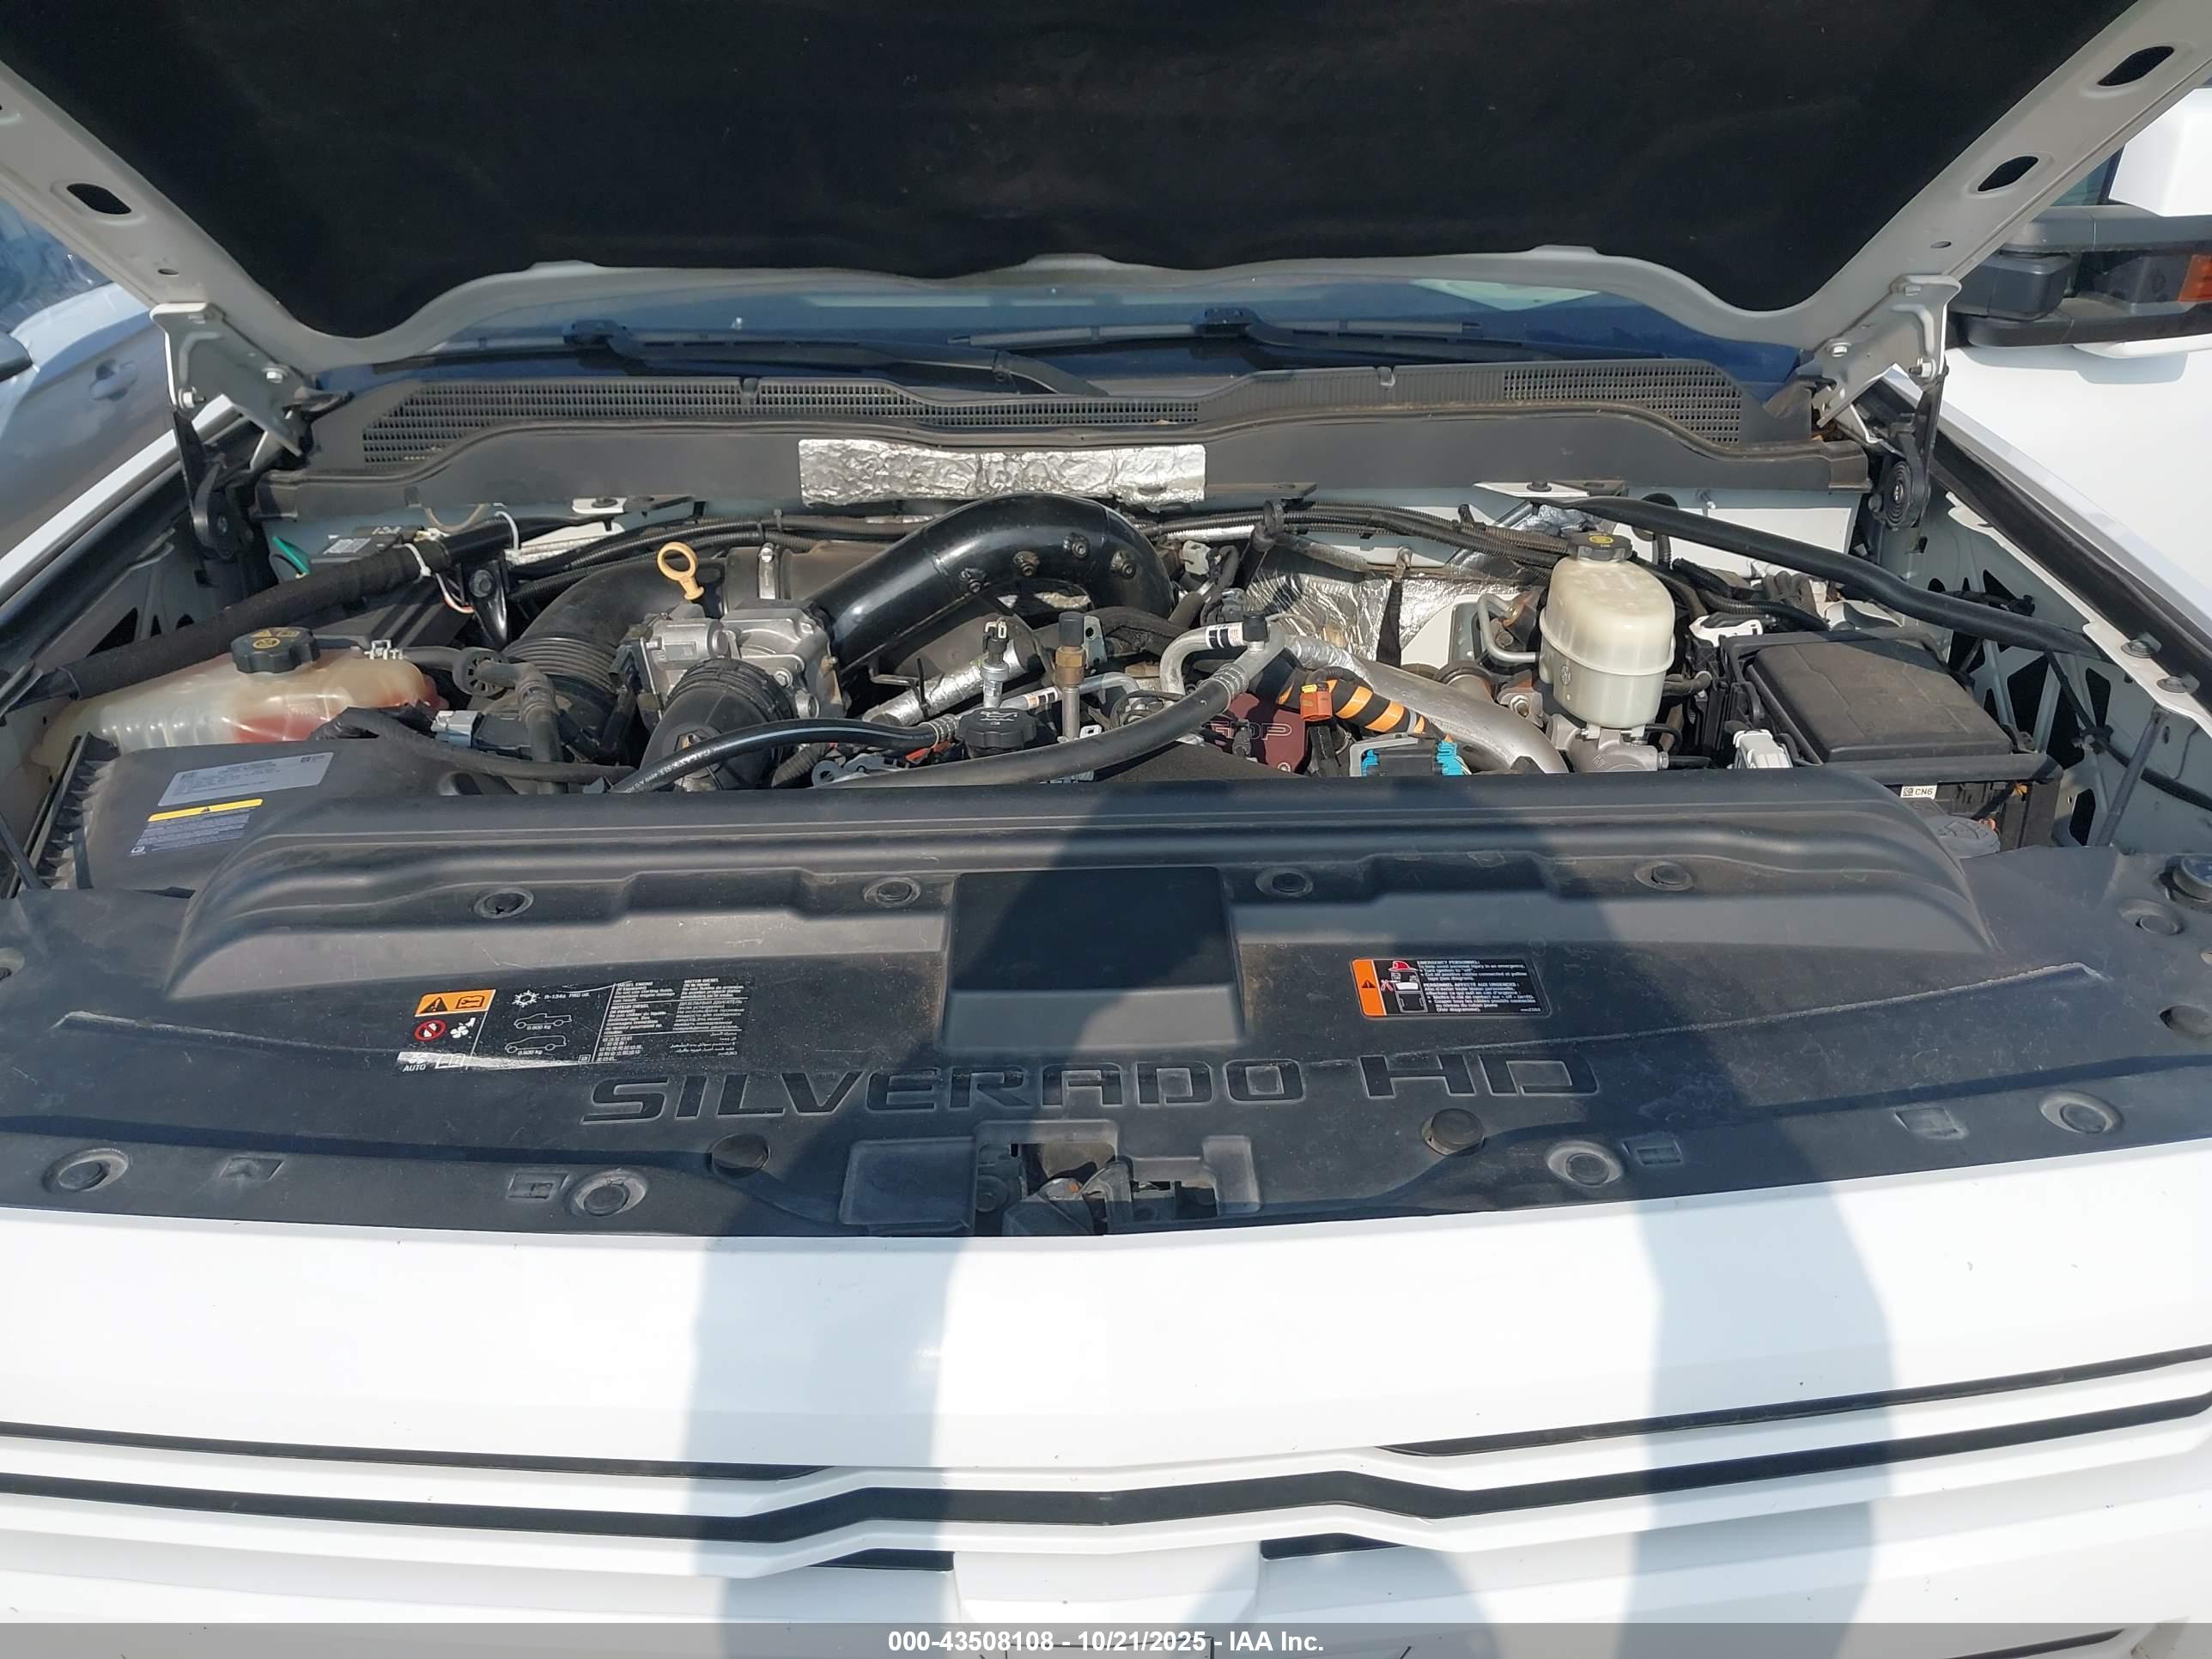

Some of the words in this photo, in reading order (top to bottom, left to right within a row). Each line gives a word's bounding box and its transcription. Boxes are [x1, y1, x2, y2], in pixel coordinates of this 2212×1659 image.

[402, 1064, 426, 1073] AUTO
[582, 1058, 1308, 1123] SILVERADO
[1358, 1054, 1601, 1099] HD
